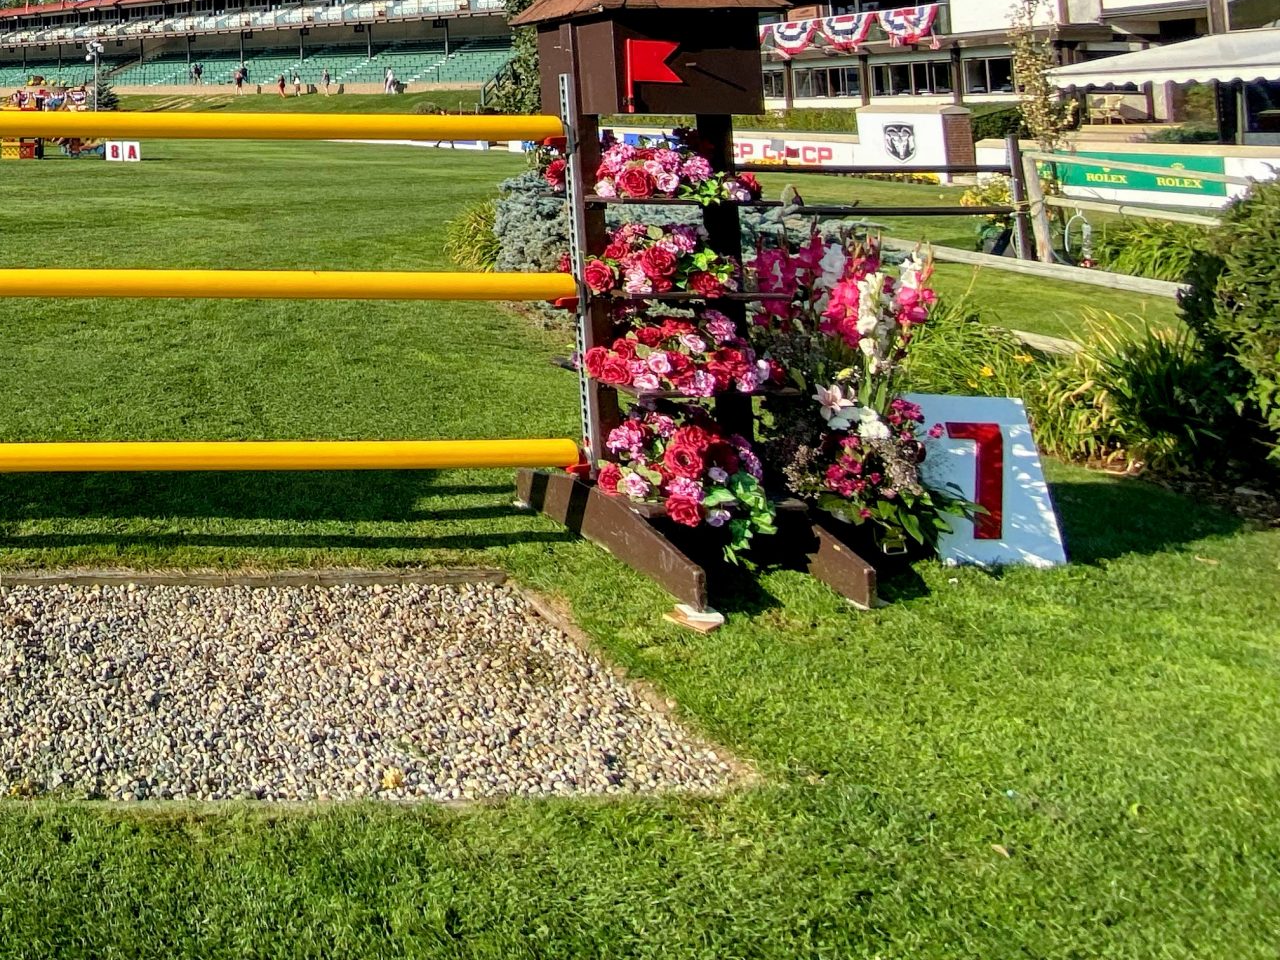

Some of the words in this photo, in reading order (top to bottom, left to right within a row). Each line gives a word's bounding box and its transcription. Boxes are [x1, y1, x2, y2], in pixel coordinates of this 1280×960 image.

[111, 144, 120, 158] 8
[128, 145, 137, 159] A
[802, 146, 832, 163] CP
[1086, 172, 1128, 184] ROLEX
[1156, 177, 1203, 189] ROLEX
